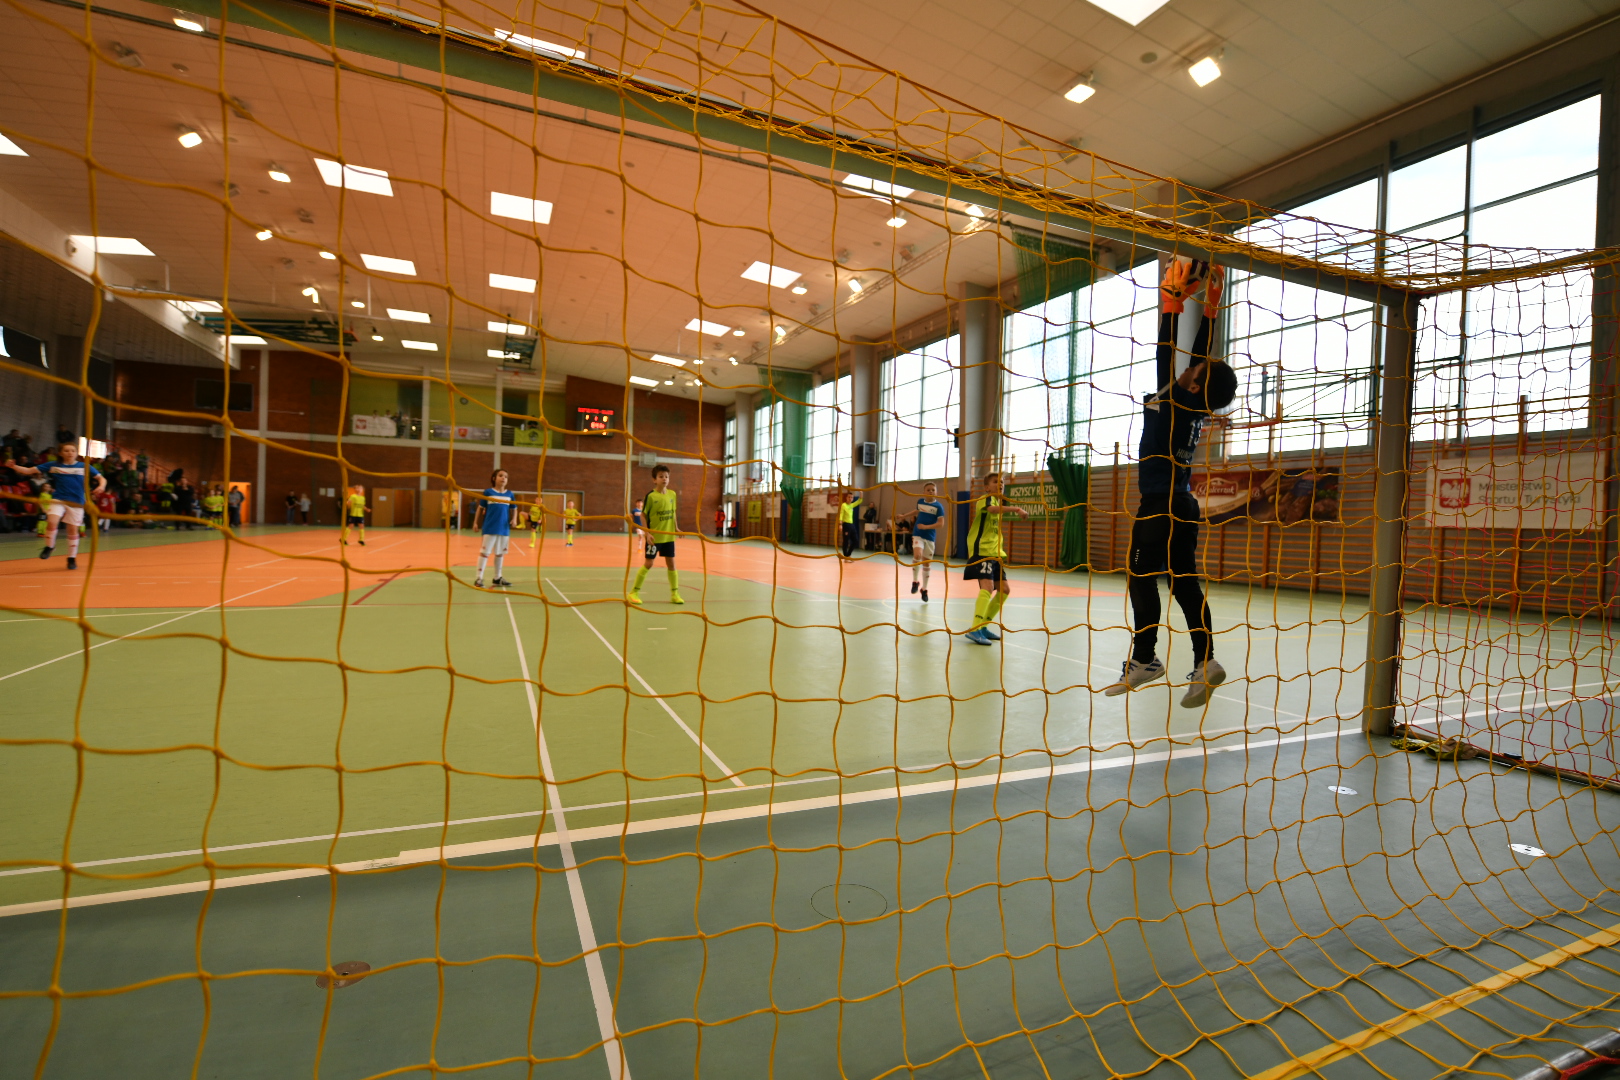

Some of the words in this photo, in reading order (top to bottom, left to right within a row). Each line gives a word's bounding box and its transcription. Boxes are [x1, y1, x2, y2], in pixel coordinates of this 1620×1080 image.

[1010, 486, 1036, 497] WSZYSCY
[646, 544, 657, 556] 29
[980, 561, 993, 575] 25
